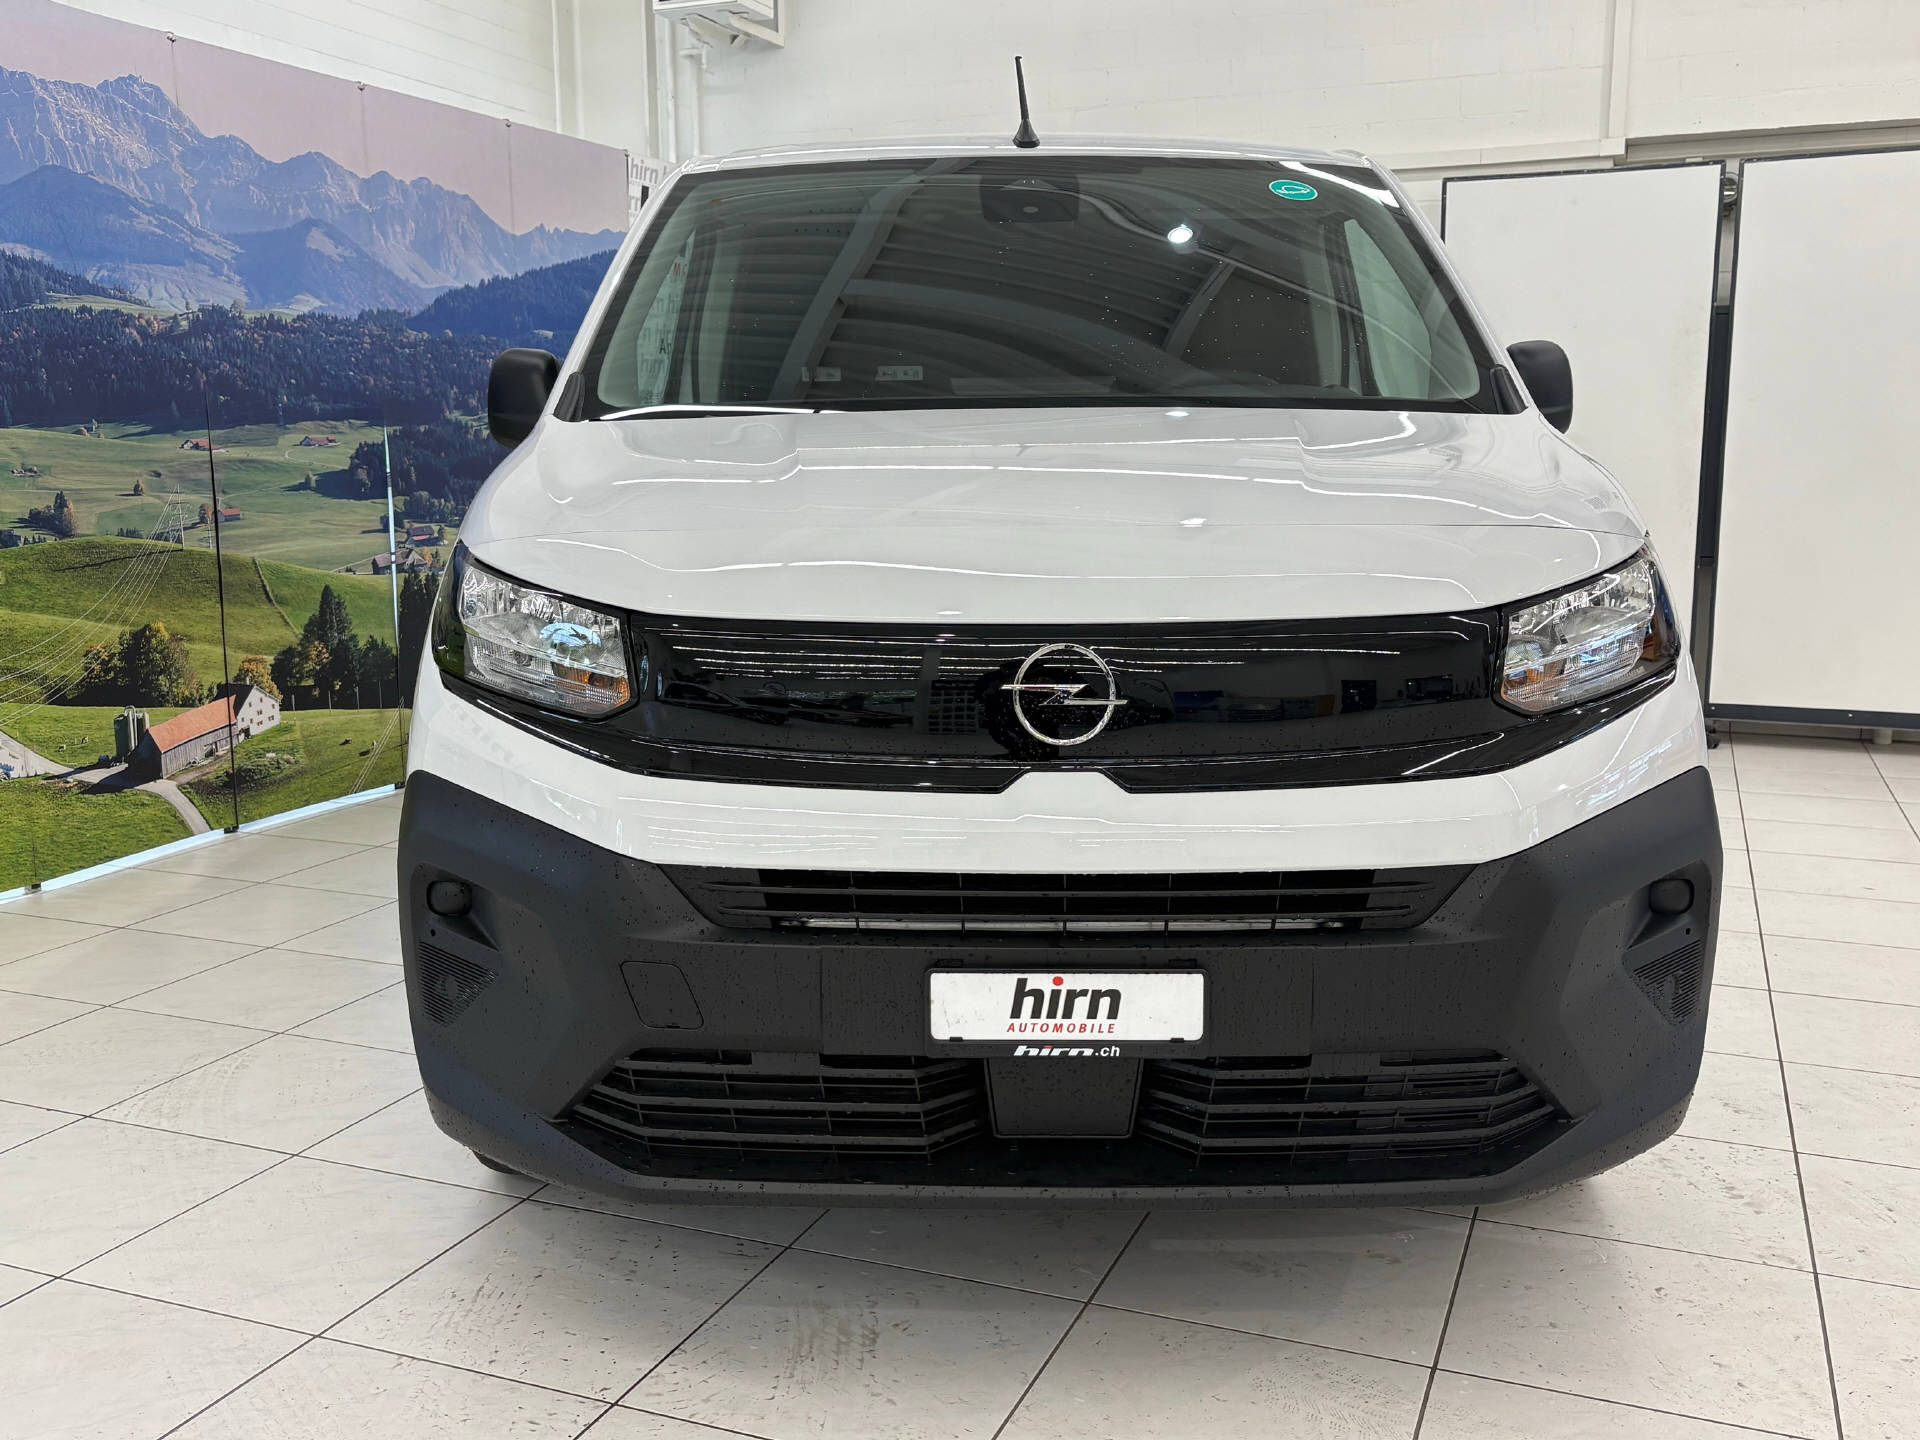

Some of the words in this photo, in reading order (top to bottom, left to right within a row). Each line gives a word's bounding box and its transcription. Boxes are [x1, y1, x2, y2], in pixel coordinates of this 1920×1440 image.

[630, 158, 658, 184] hirn
[1009, 976, 1121, 1020] hirn
[1007, 1022, 1115, 1033] AUTOMOBILE
[1013, 1045, 1120, 1057] hirn.ch
